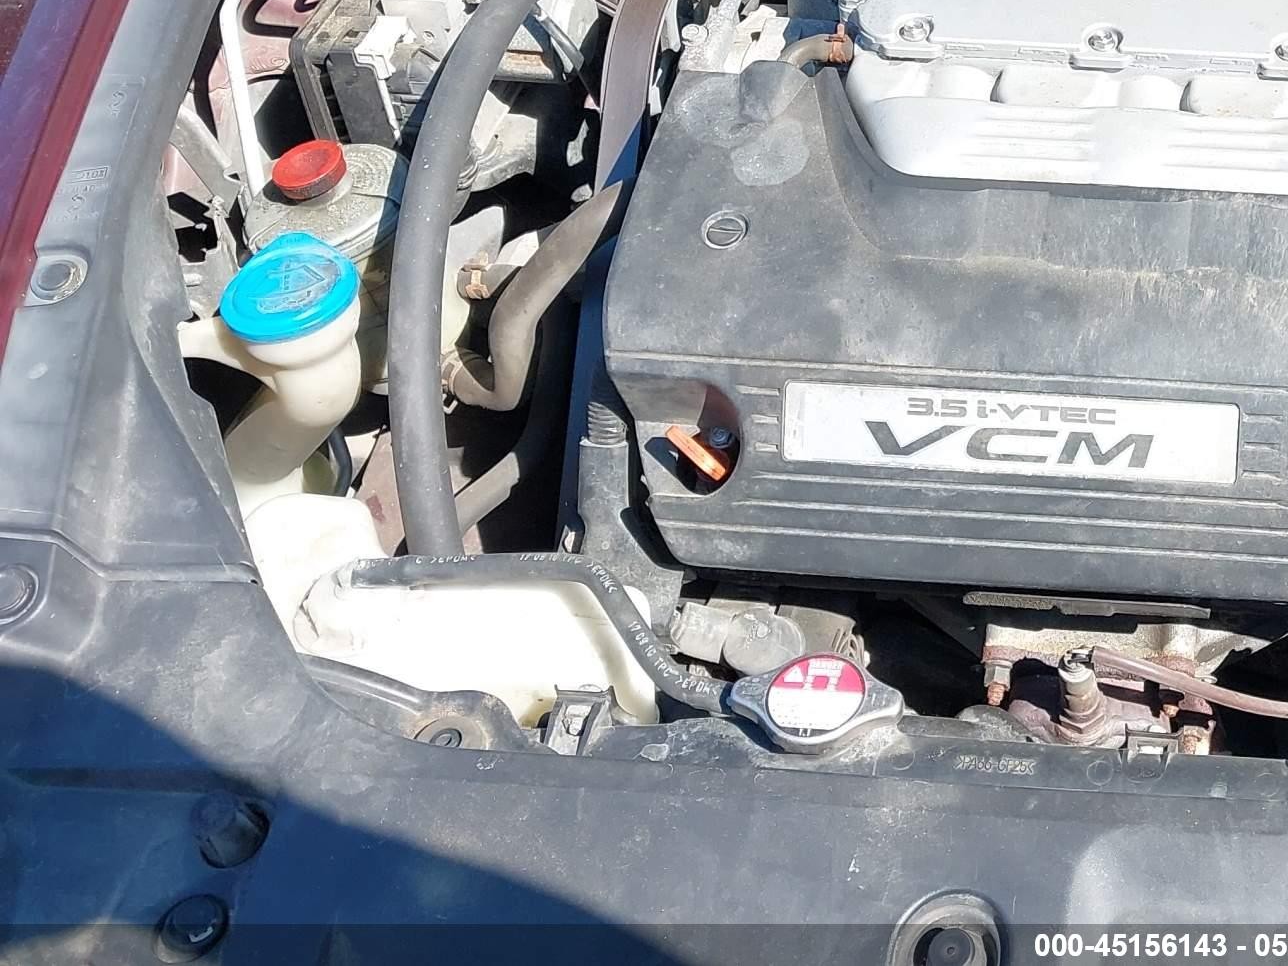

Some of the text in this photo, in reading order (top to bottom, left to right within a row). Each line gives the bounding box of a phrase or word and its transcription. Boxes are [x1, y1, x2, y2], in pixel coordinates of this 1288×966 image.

[907, 397, 1116, 425] 3.5 i-VTEC
[865, 420, 1154, 468] VCM
